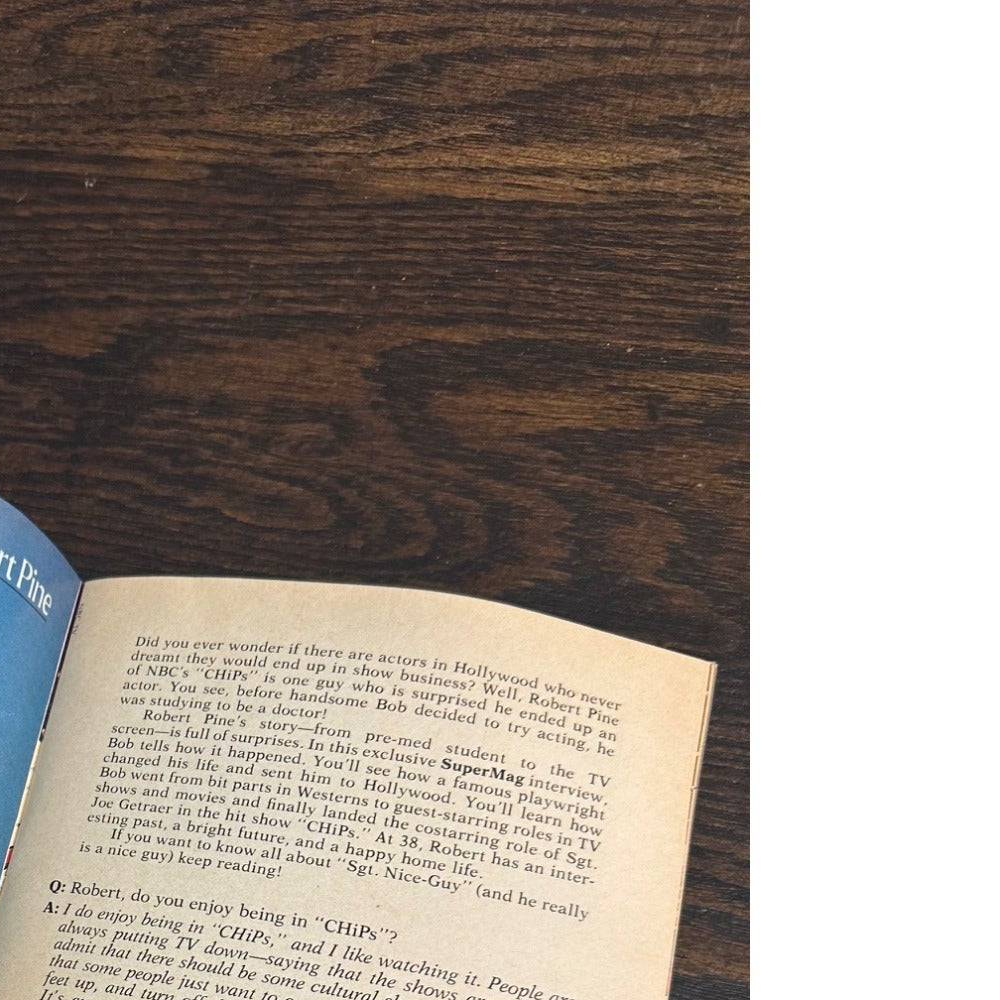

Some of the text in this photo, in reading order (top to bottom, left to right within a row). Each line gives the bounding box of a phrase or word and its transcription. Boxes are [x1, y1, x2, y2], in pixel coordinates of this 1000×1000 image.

[18, 559, 54, 617] Pine
[135, 637, 622, 710] Did you ever wonder if there are actors in Hollywood who never
[120, 695, 328, 719] was studying to be a doctor!
[184, 726, 211, 740] full
[212, 729, 230, 741] of
[230, 734, 304, 749] surprises.
[307, 738, 324, 752] In
[329, 740, 358, 756] this
[362, 748, 437, 768] exclusive
[440, 757, 526, 788] SuperMag
[528, 774, 608, 807] interview,
[79, 840, 282, 880] is a nice guy) keep reading!
[90, 796, 114, 809] Joe
[118, 798, 174, 814] Getraer
[177, 804, 192, 817] in
[197, 805, 221, 820] the
[225, 808, 246, 823] hit
[251, 812, 292, 829] show
[374, 831, 393, 845] At
[399, 834, 423, 852] 38,
[428, 840, 485, 862] Robert
[490, 851, 519, 869] has
[524, 862, 544, 875] an
[549, 865, 595, 885] inter-
[49, 879, 66, 895] Q:
[69, 881, 125, 902] Robert,
[130, 888, 151, 903] do
[153, 895, 184, 908] you
[188, 899, 234, 919] enjoy
[239, 902, 286, 928] being
[291, 912, 308, 928] in
[42, 901, 60, 914] A:
[63, 903, 72, 915] I
[74, 903, 94, 918] do
[97, 909, 138, 927] enjoy
[140, 911, 184, 935] being
[187, 919, 205, 934] in
[290, 940, 326, 955] and
[328, 943, 338, 957] I
[342, 945, 373, 964] like
[378, 956, 459, 986] watching
[464, 971, 481, 987] it.
[487, 976, 544, 1000] People
